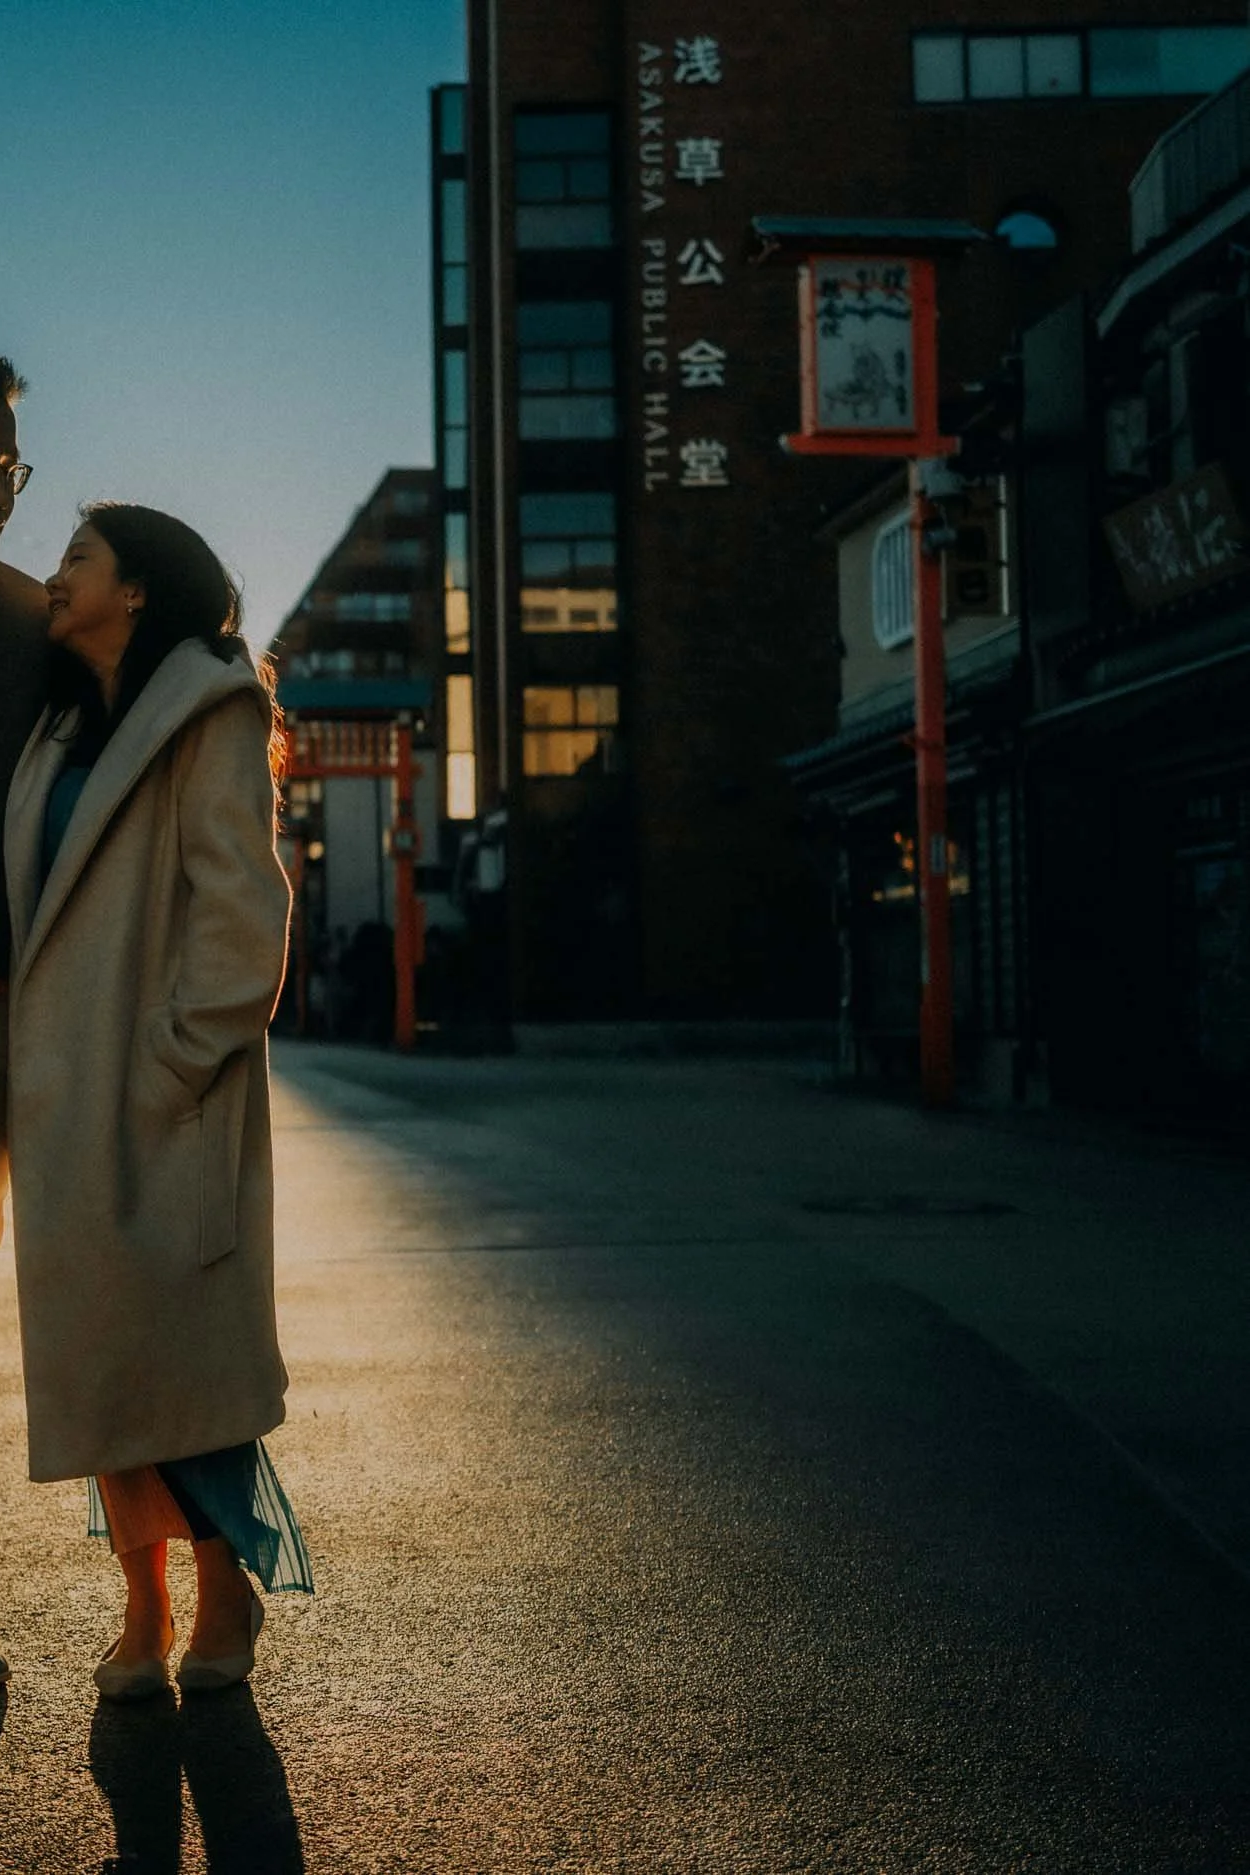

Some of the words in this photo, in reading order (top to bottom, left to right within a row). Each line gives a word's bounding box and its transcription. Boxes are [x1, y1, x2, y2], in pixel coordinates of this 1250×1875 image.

[638, 42, 665, 213] ASAKUSA
[641, 238, 669, 373] PUBLIC
[673, 35, 730, 488] 浅草公会堂
[643, 391, 670, 492] HALL
